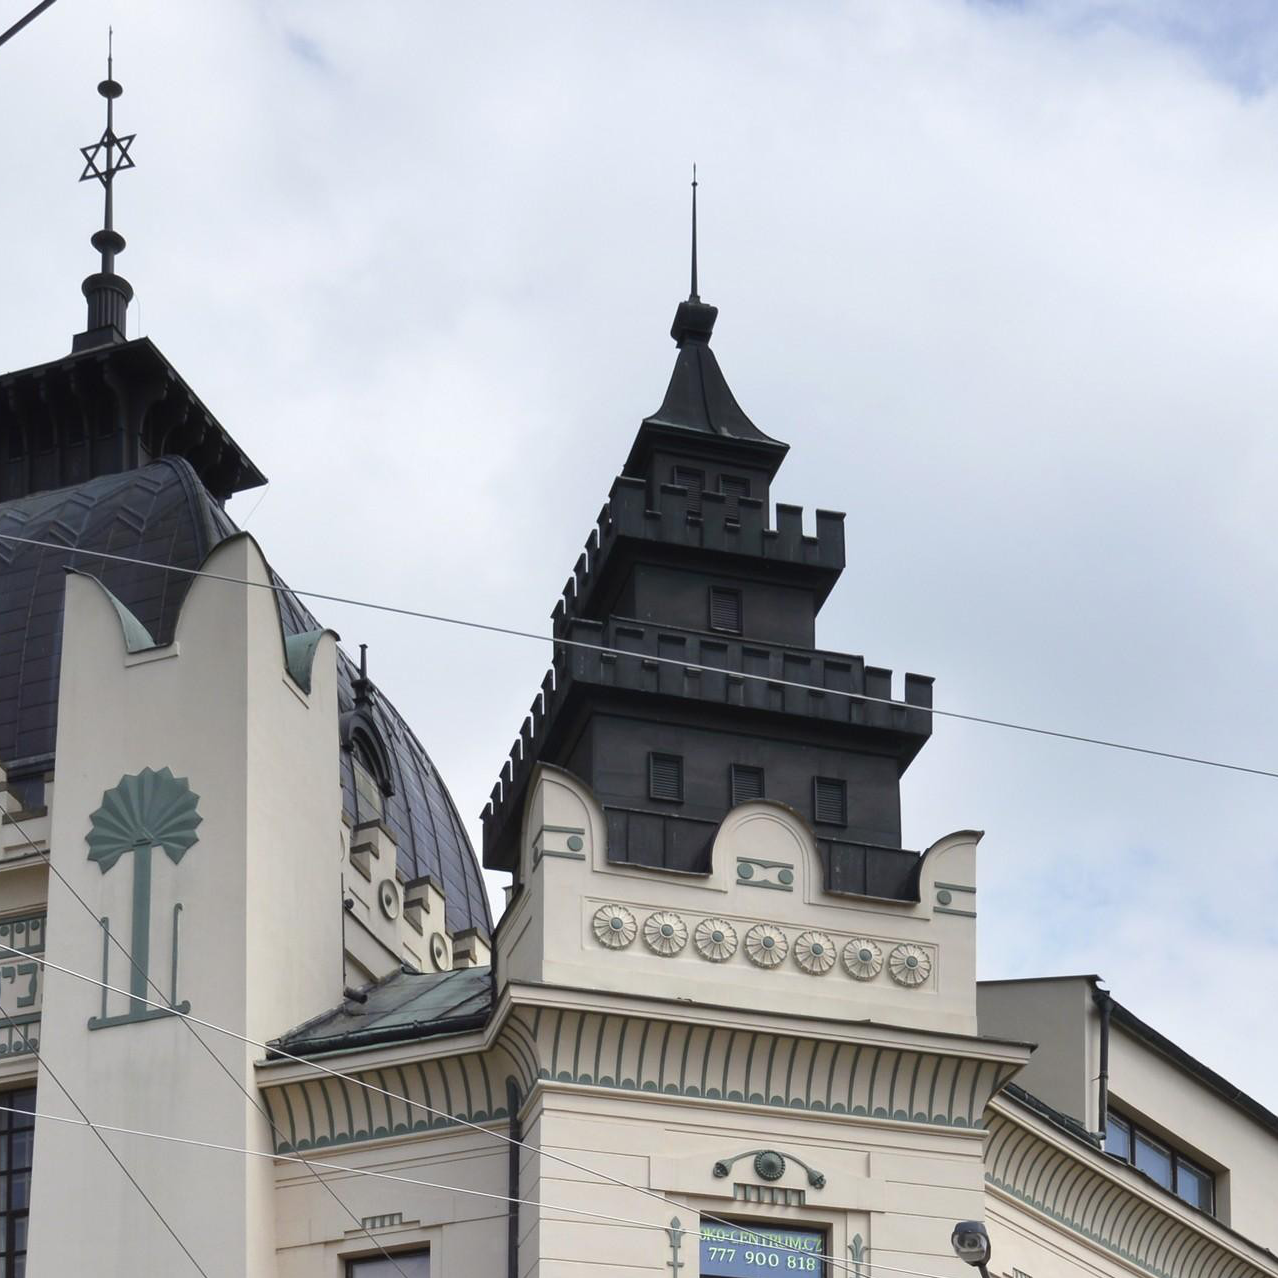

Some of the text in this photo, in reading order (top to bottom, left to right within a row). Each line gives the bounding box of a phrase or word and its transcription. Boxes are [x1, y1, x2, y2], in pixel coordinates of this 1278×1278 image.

[708, 1246, 816, 1271] 777 900 818
